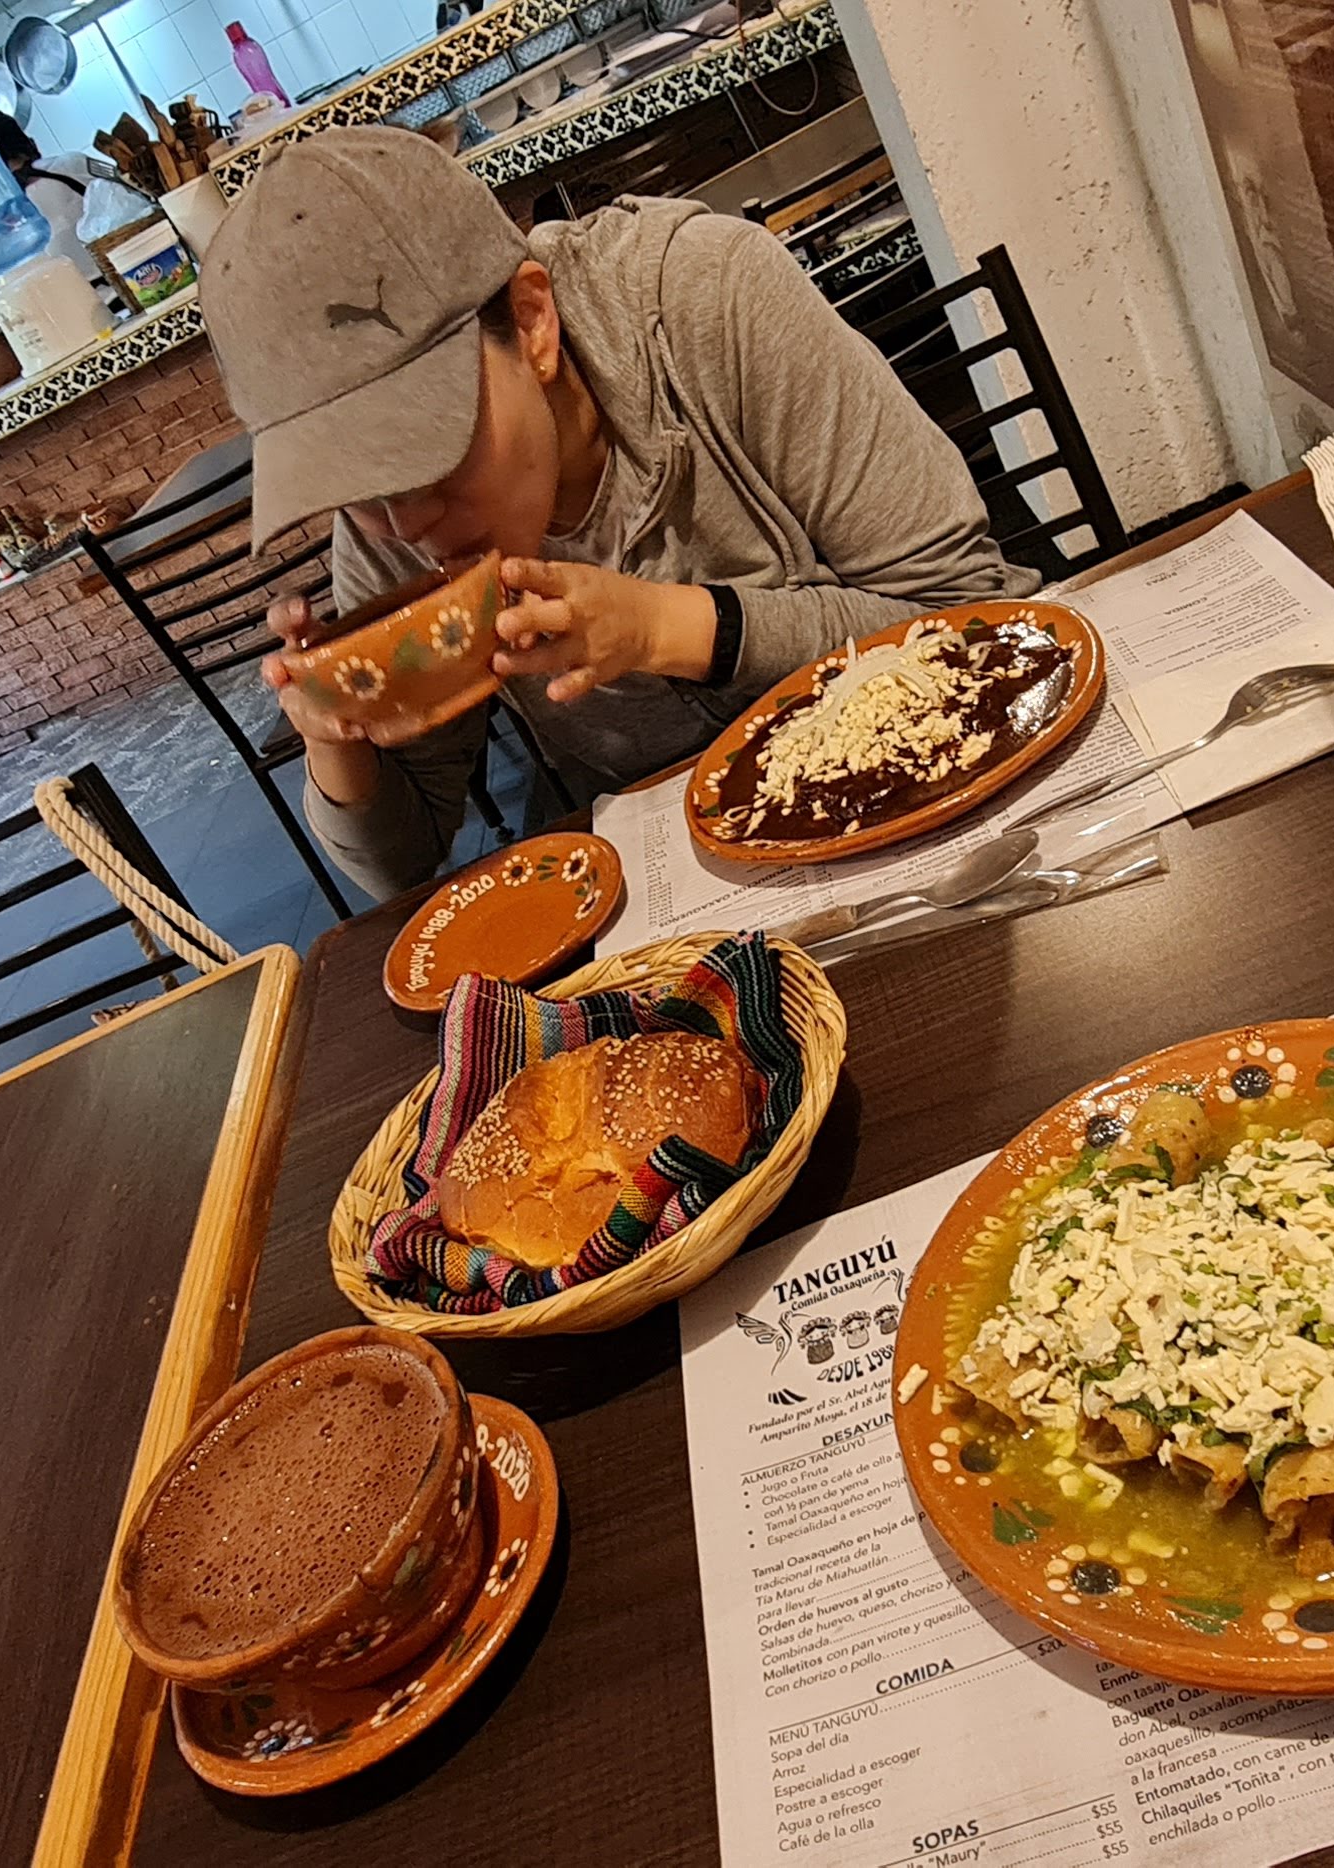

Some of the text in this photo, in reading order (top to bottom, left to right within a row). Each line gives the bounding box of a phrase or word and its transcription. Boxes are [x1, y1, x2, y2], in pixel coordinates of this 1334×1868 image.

[419, 874, 496, 939] 1988-2020
[773, 1235, 897, 1304] TANGUYÚ
[791, 1269, 888, 1311] Comida Oaxaqueña
[816, 1356, 864, 1383] DESDE
[822, 1412, 894, 1446] DESAYUN
[741, 1436, 865, 1486] ALMUERZO TANGUYÚ
[751, 1515, 915, 1578] Tamal Oaxaqueño en hoja de
[758, 1578, 909, 1636] Orden de huevos al gusto
[761, 1636, 829, 1666] Combinada
[763, 1603, 970, 1682] Molletitos con pan virote y quesillo
[875, 1658, 956, 1694] COMIDA
[769, 1700, 878, 1746] MENÚ TANGUYÚ
[1111, 1697, 1174, 1728] Baguette
[1118, 1712, 1187, 1746] don Abel,
[770, 1732, 849, 1763] Sopa del día
[1124, 1724, 1215, 1765] oaxaquesillo,
[772, 1764, 806, 1781] Arroz
[1130, 1747, 1217, 1785] a la francesa
[1134, 1766, 1230, 1805] Entomatado,
[1233, 1755, 1261, 1771] con
[1264, 1742, 1306, 1760] carne
[1306, 1731, 1331, 1746] de
[1141, 1791, 1222, 1824] Chilaquiles
[1297, 1757, 1326, 1773] con
[1091, 1801, 1117, 1820] $55
[1148, 1812, 1219, 1845] enchilada
[1222, 1810, 1233, 1821] o
[1236, 1794, 1275, 1821] pollo
[778, 1817, 874, 1851] Café de la olla
[912, 1819, 979, 1853] SOPAS
[1096, 1820, 1123, 1840] $55
[1102, 1840, 1129, 1860] $55
